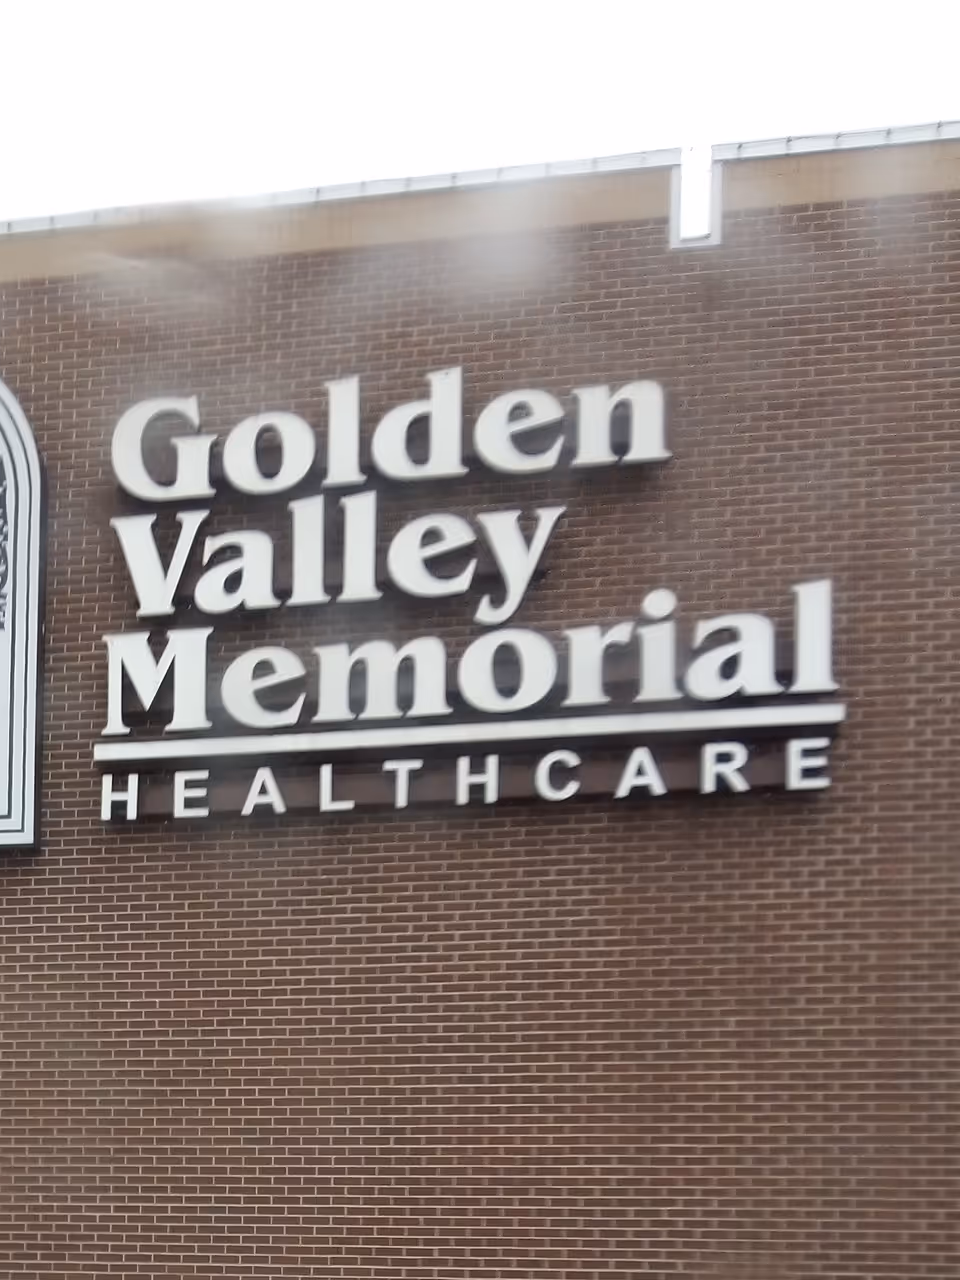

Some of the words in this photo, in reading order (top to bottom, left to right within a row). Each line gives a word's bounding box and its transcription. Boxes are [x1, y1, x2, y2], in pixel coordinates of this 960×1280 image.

[110, 366, 672, 501] Golden
[110, 491, 566, 625] Valley
[101, 579, 839, 736] Memorial
[100, 737, 831, 821] HEALTHCARE
